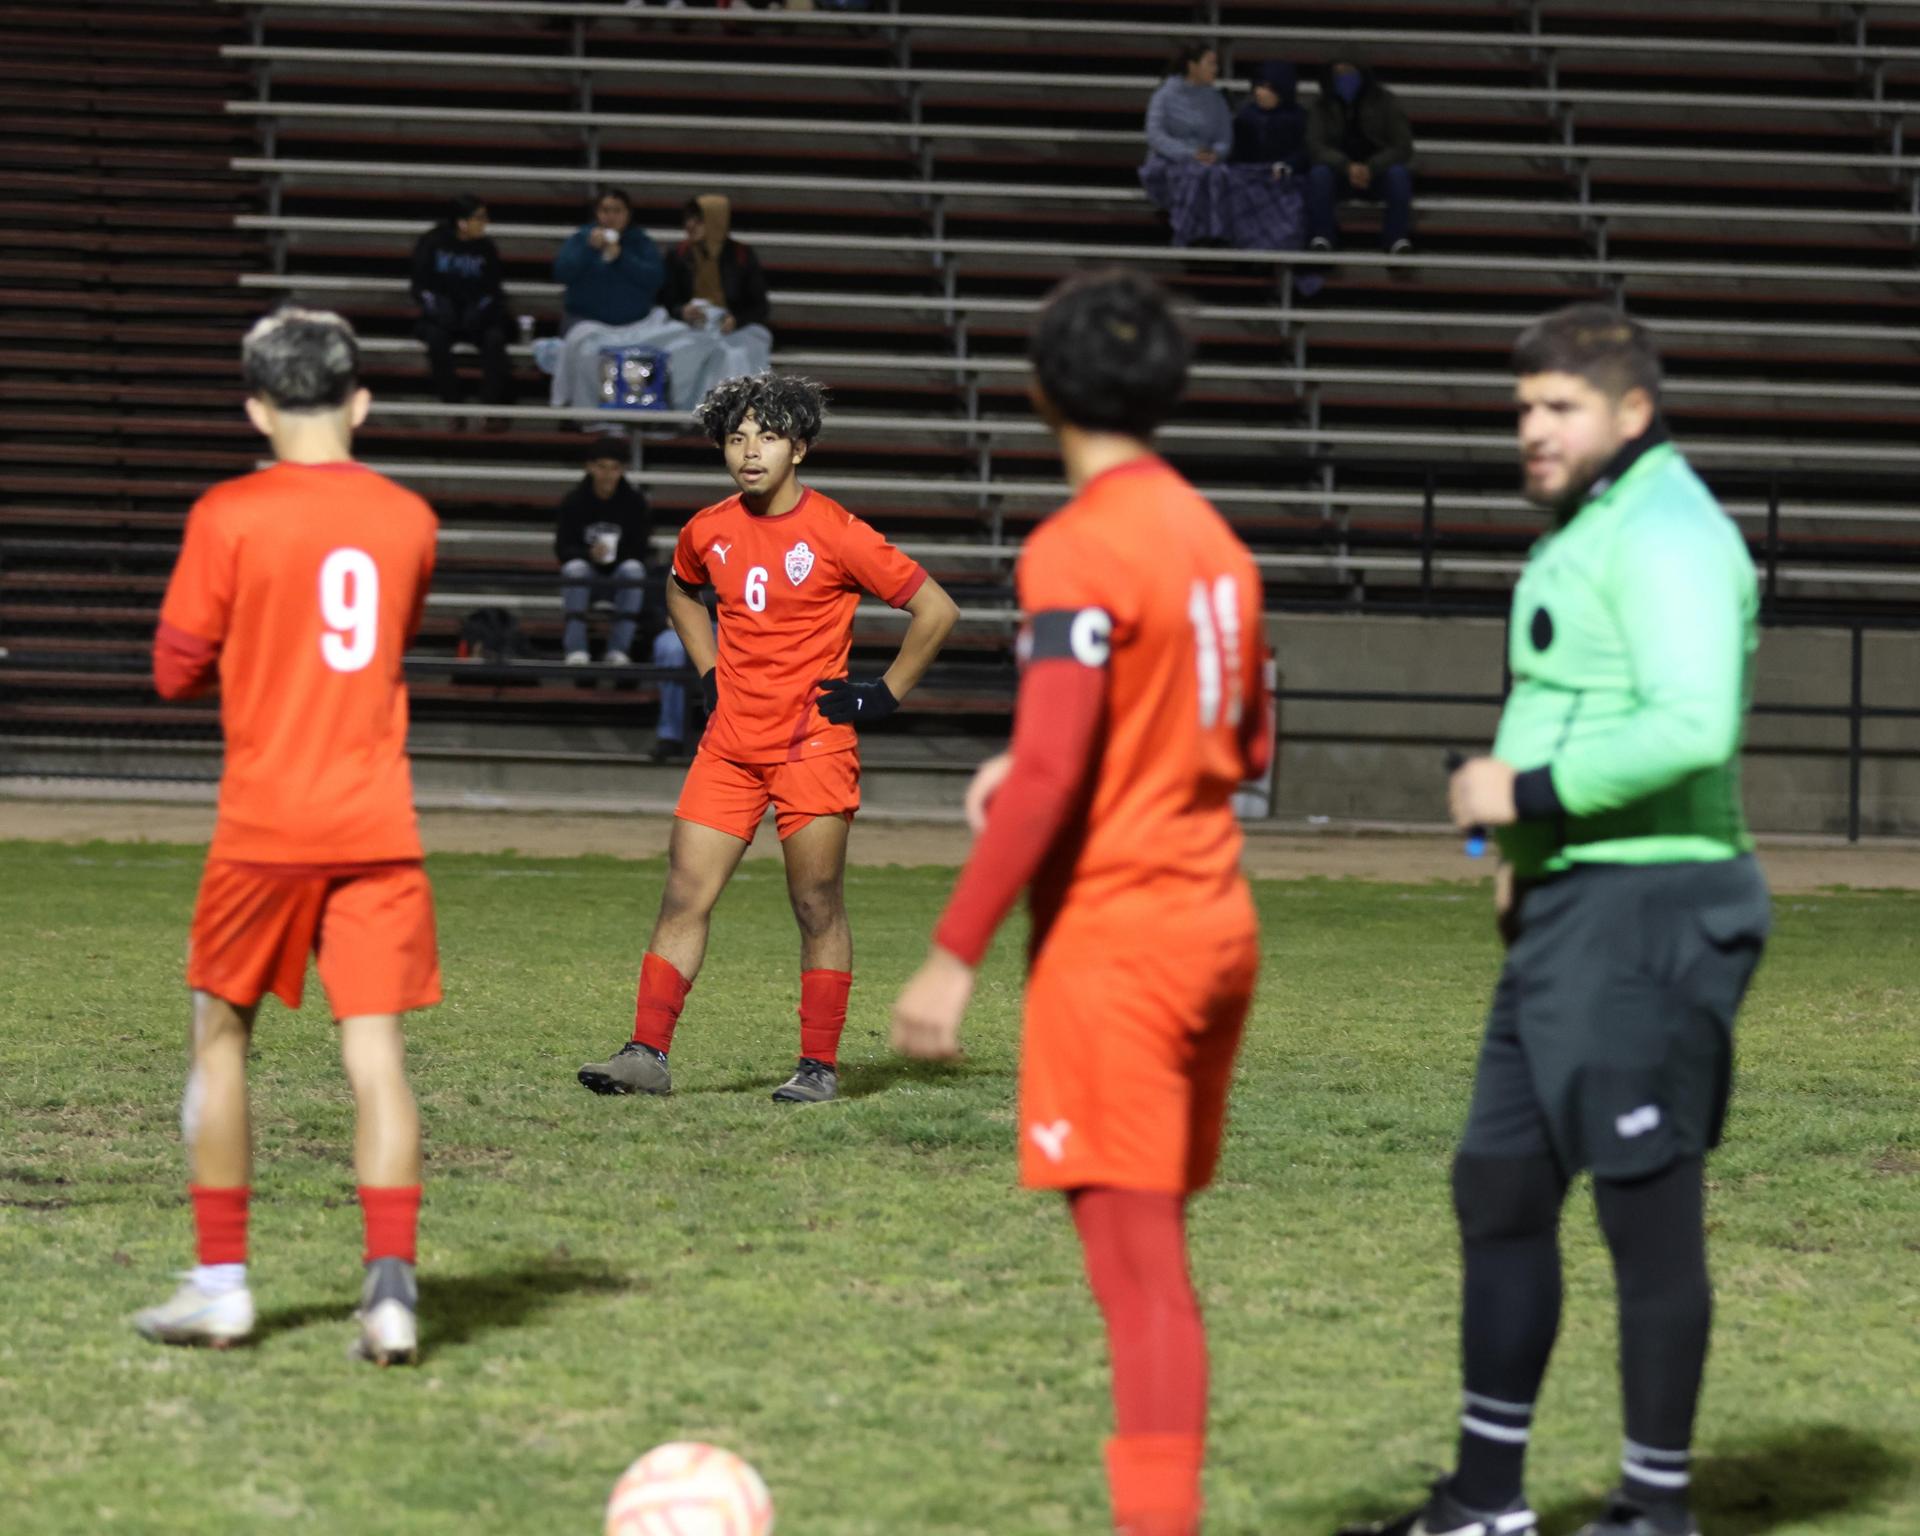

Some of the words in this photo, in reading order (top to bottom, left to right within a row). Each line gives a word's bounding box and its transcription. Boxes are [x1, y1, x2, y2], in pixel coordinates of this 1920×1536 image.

[319, 546, 379, 672] 9
[745, 566, 769, 612] 6
[1070, 606, 1112, 668] C
